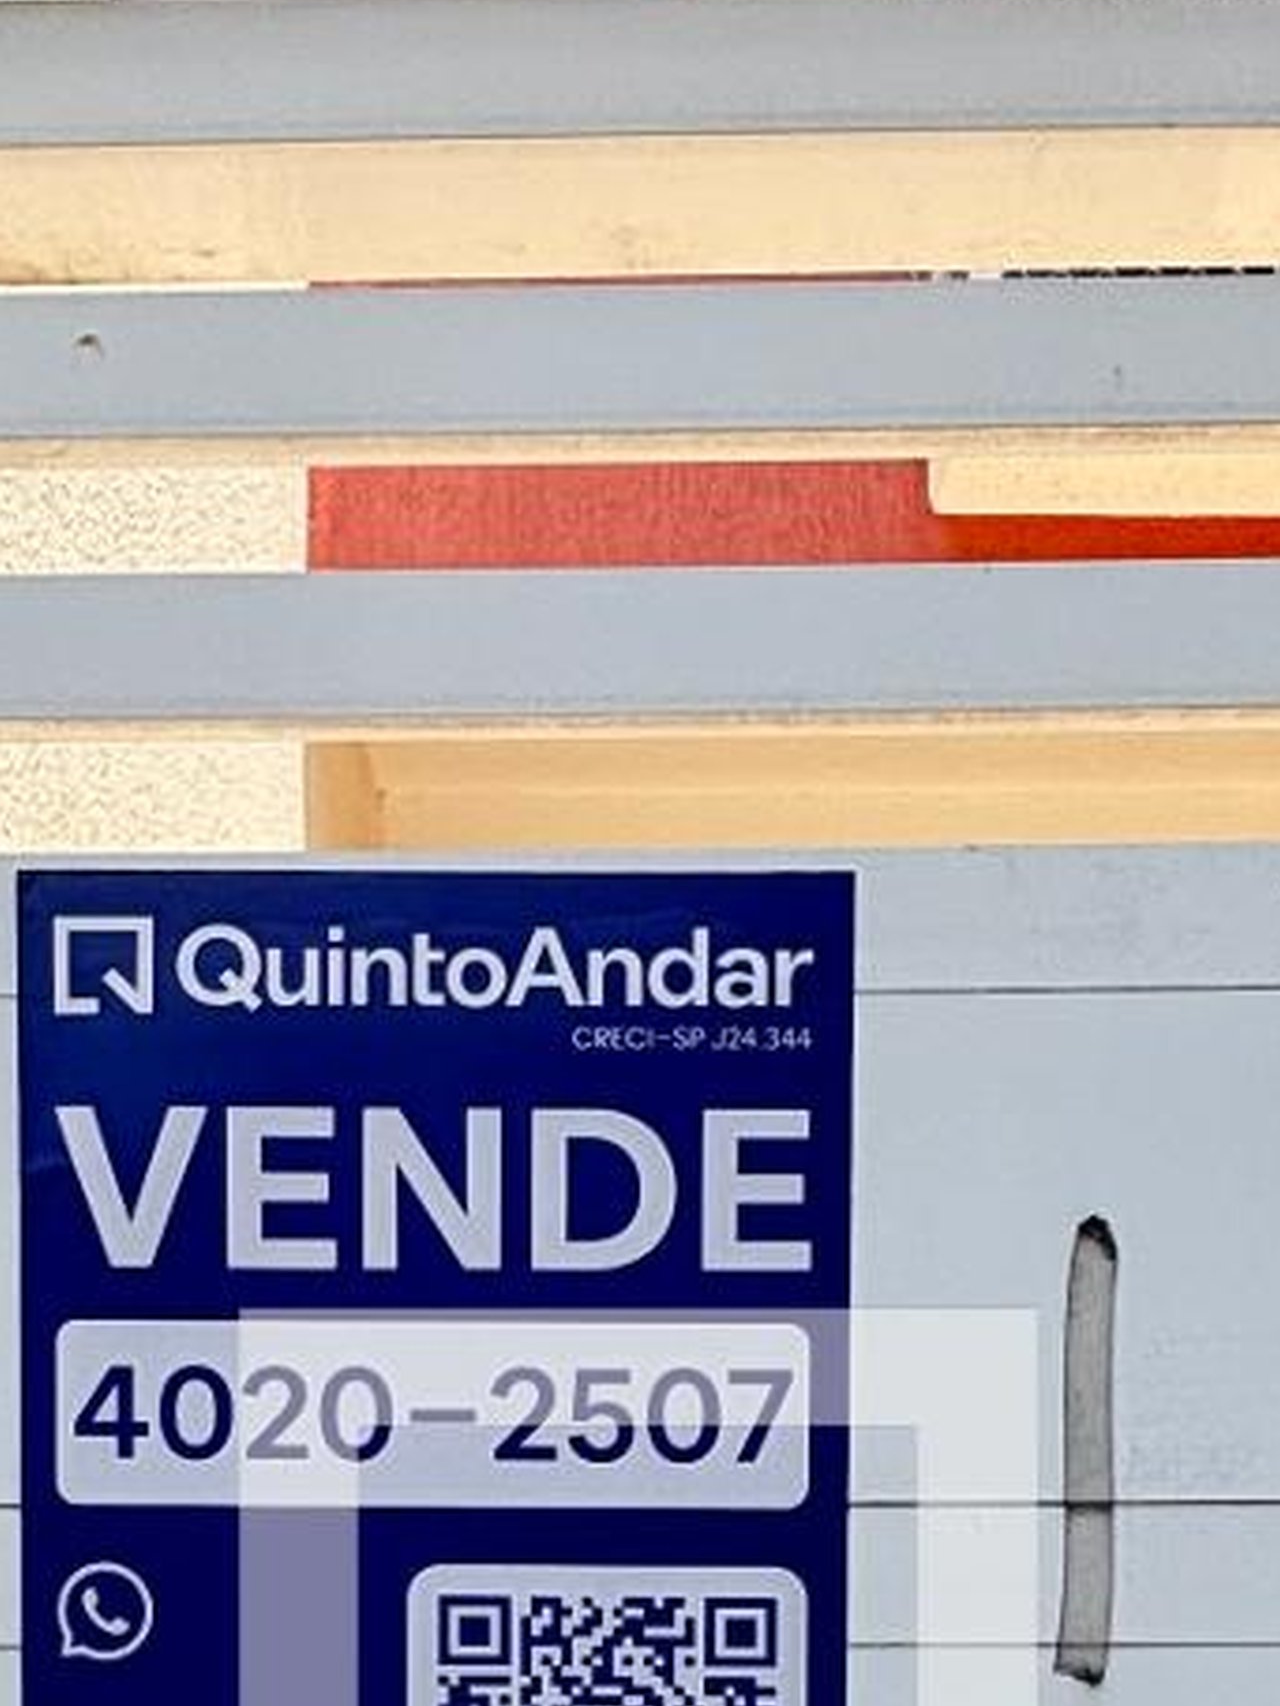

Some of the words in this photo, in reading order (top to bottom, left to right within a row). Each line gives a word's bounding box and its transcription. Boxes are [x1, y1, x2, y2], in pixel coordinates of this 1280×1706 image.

[175, 923, 814, 1012] QuintoAndar
[571, 1025, 707, 1051] CRECI-SP
[54, 1105, 813, 1271] VENDE
[72, 1363, 795, 1465] 4020-2507
